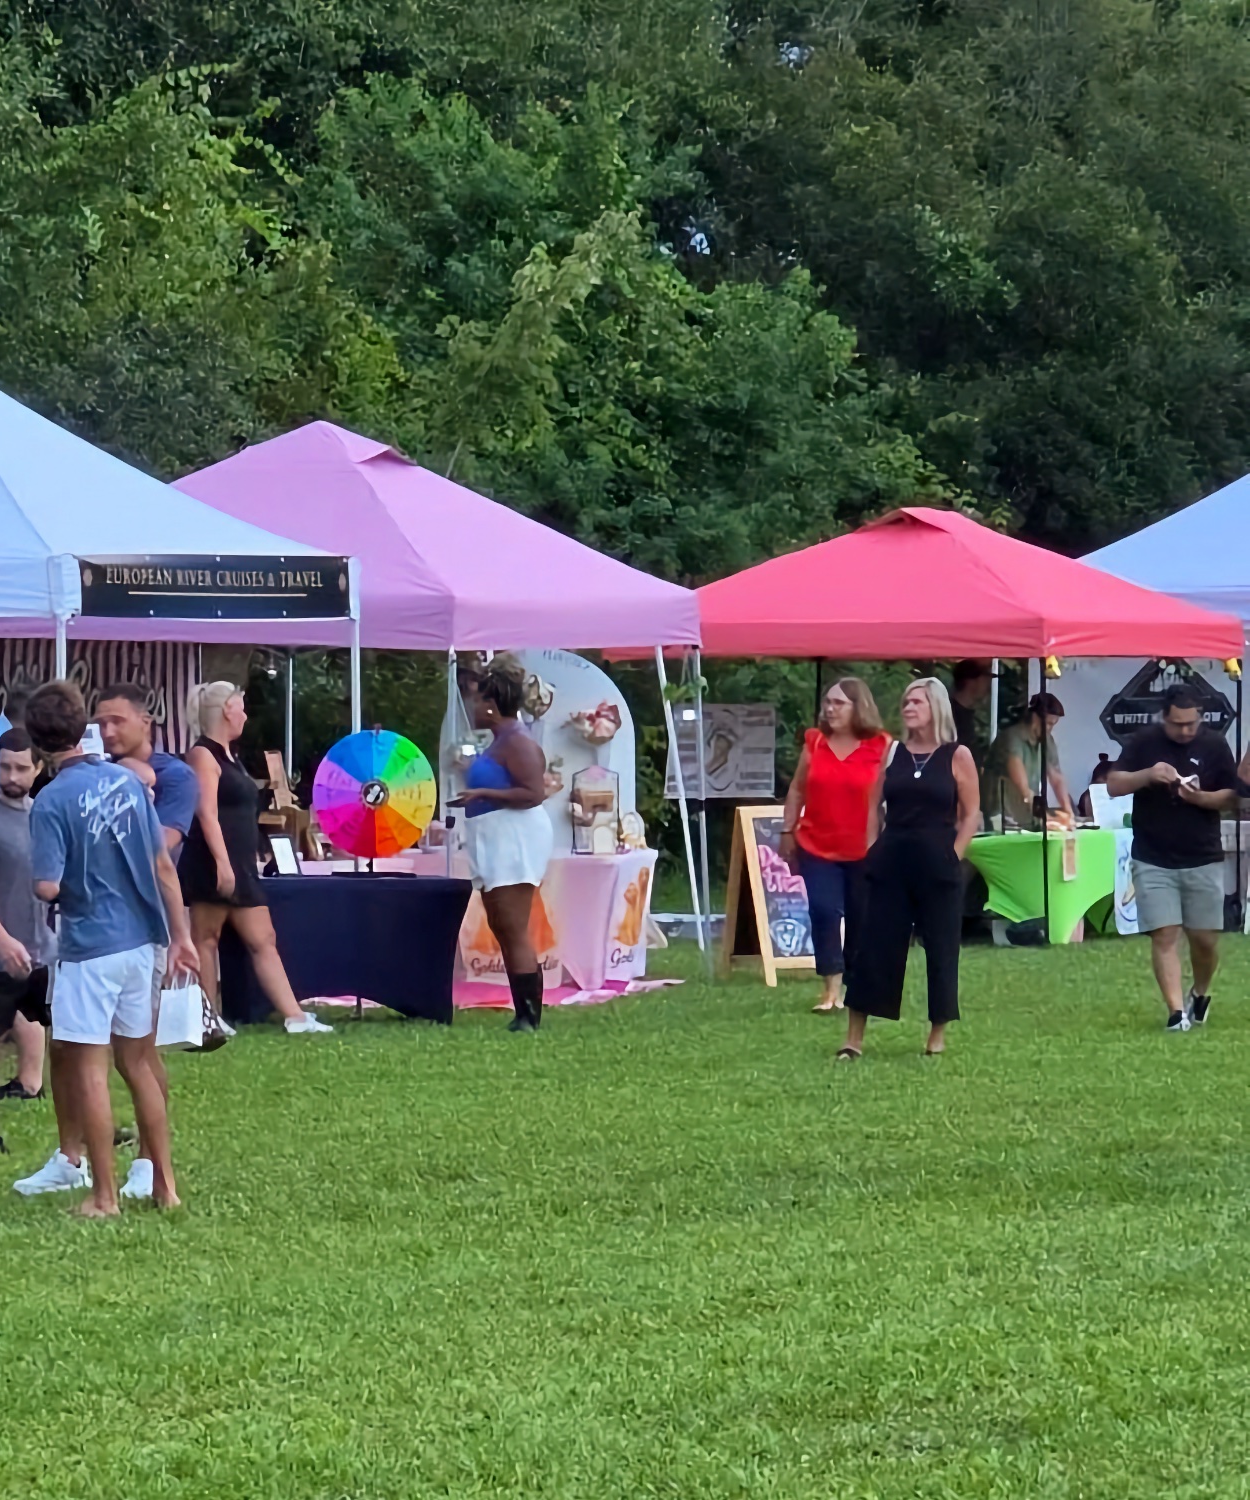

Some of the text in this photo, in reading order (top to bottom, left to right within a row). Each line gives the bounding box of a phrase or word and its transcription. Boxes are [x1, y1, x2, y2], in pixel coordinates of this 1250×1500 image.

[106, 566, 172, 585] EUROPEAN
[177, 569, 213, 586] RIVER
[216, 570, 264, 587] CRUISES
[280, 570, 324, 588] TRAVEL
[1113, 712, 1149, 725] WHITE
